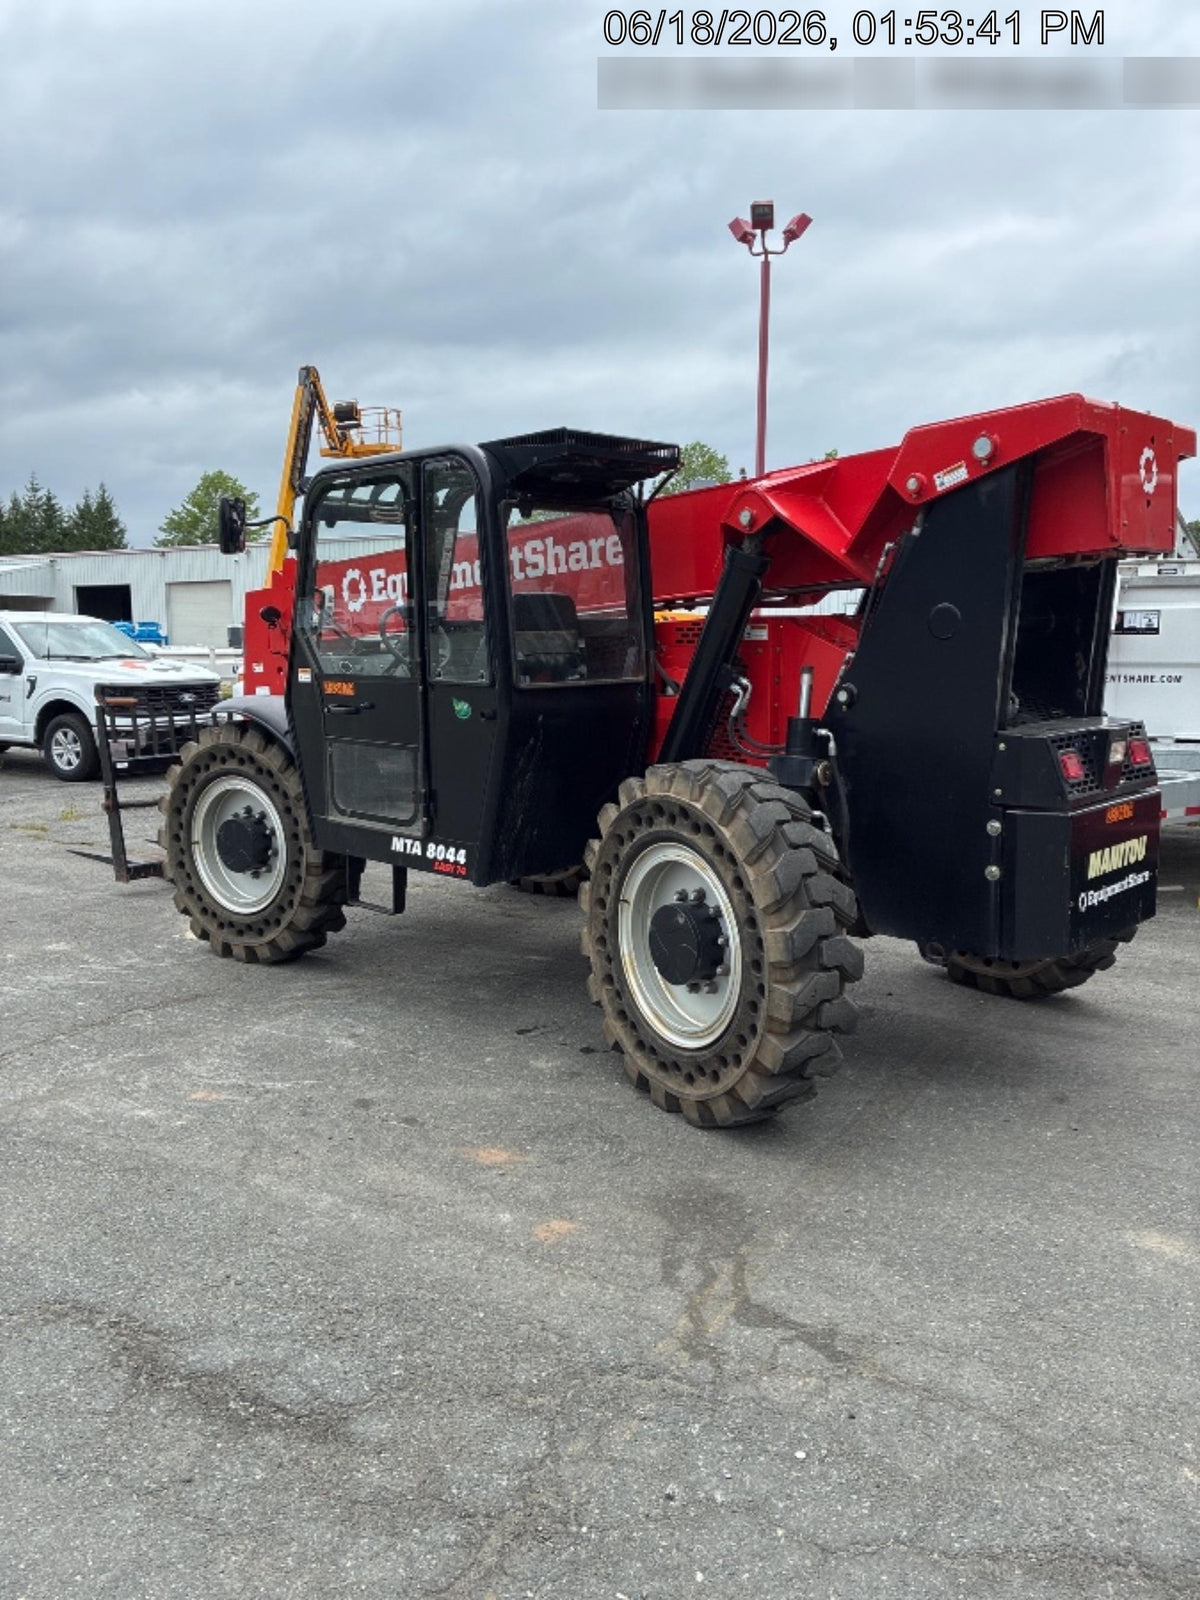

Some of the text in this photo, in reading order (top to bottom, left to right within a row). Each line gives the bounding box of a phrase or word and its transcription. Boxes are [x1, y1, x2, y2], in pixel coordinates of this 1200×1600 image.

[391, 836, 467, 865] MTA 8044
[1087, 834, 1148, 880] MANITOU
